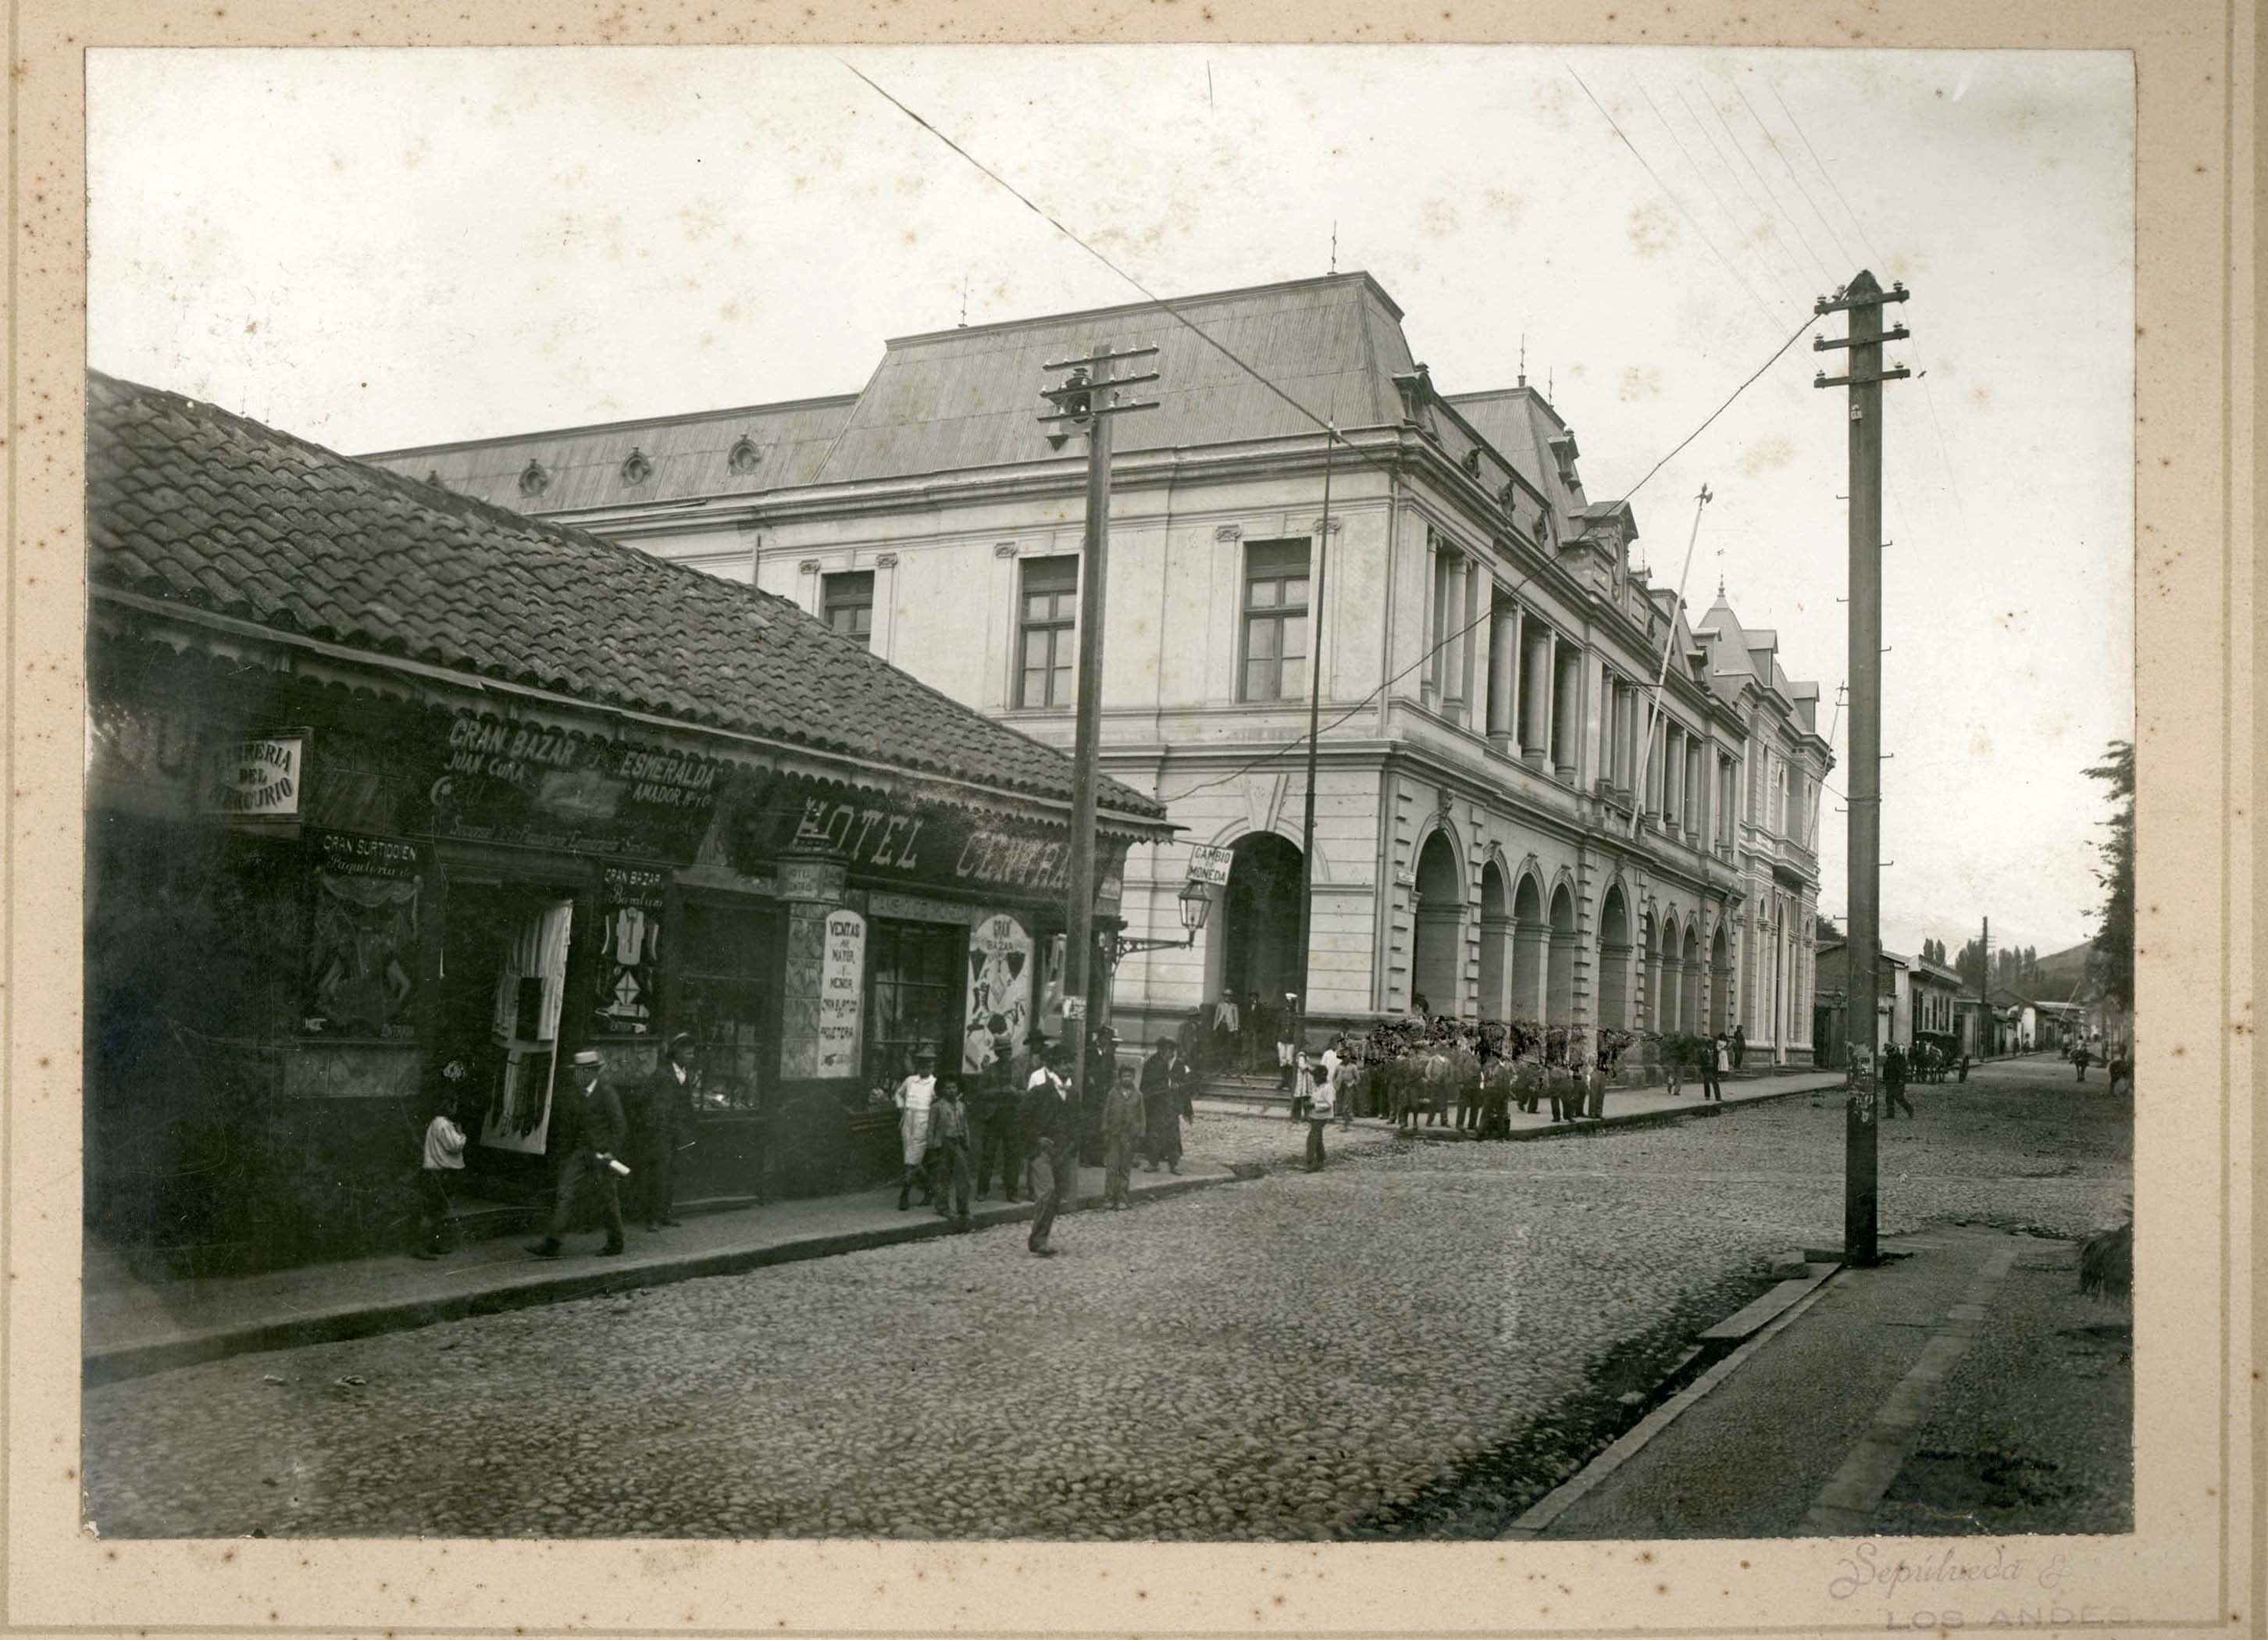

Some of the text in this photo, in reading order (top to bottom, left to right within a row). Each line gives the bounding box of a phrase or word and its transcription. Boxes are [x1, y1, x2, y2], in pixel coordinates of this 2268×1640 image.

[449, 718, 508, 754] GRAN
[508, 729, 577, 766] BAZAR
[237, 767, 267, 785] DEL
[633, 783, 682, 807] AMADOR
[790, 797, 924, 869] HOTEL
[323, 834, 417, 862] GRAN SURTIDO EN
[1195, 847, 1231, 864] CAMBIO
[955, 830, 1072, 890] CENTRA
[1189, 866, 1226, 882] MONEDA
[829, 921, 861, 939] VENTAS
[986, 939, 1015, 951] BAZAR
[1885, 1609, 1965, 1632] LOS
